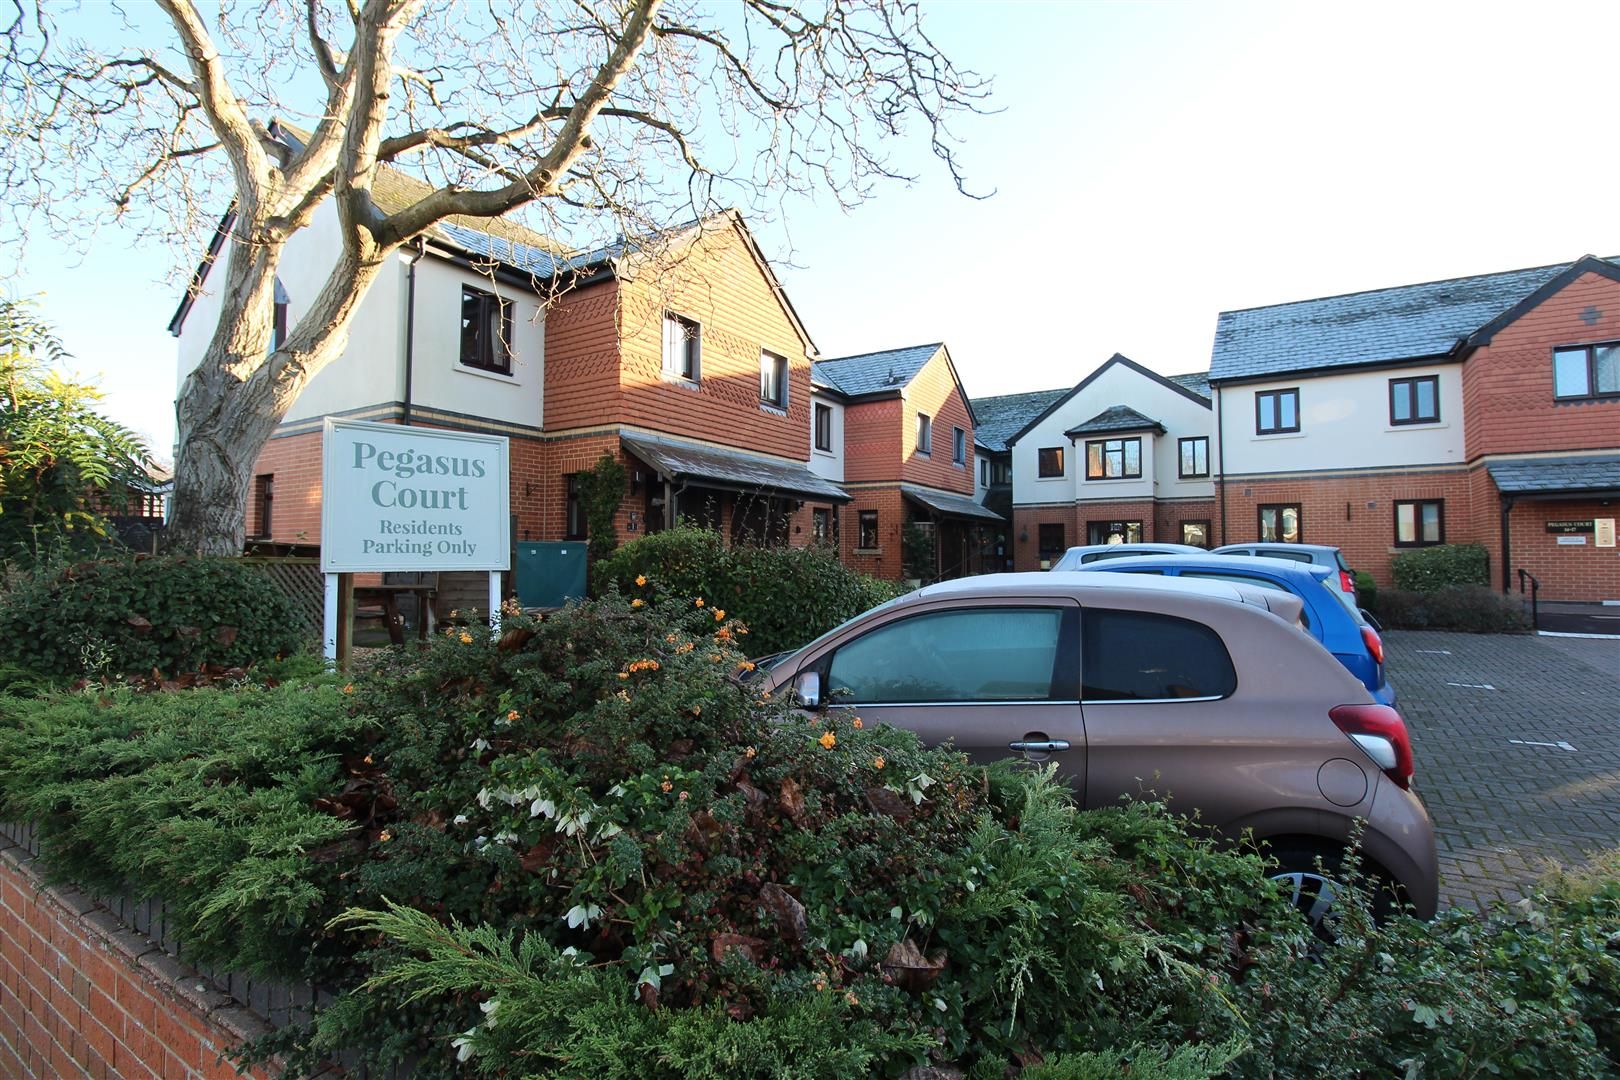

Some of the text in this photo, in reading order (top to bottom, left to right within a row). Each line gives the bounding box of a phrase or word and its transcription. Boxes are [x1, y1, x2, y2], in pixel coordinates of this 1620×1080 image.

[352, 441, 486, 479] Pegasus
[371, 480, 469, 511] Court
[380, 519, 463, 536] Residents
[362, 539, 477, 557] Parking Only
